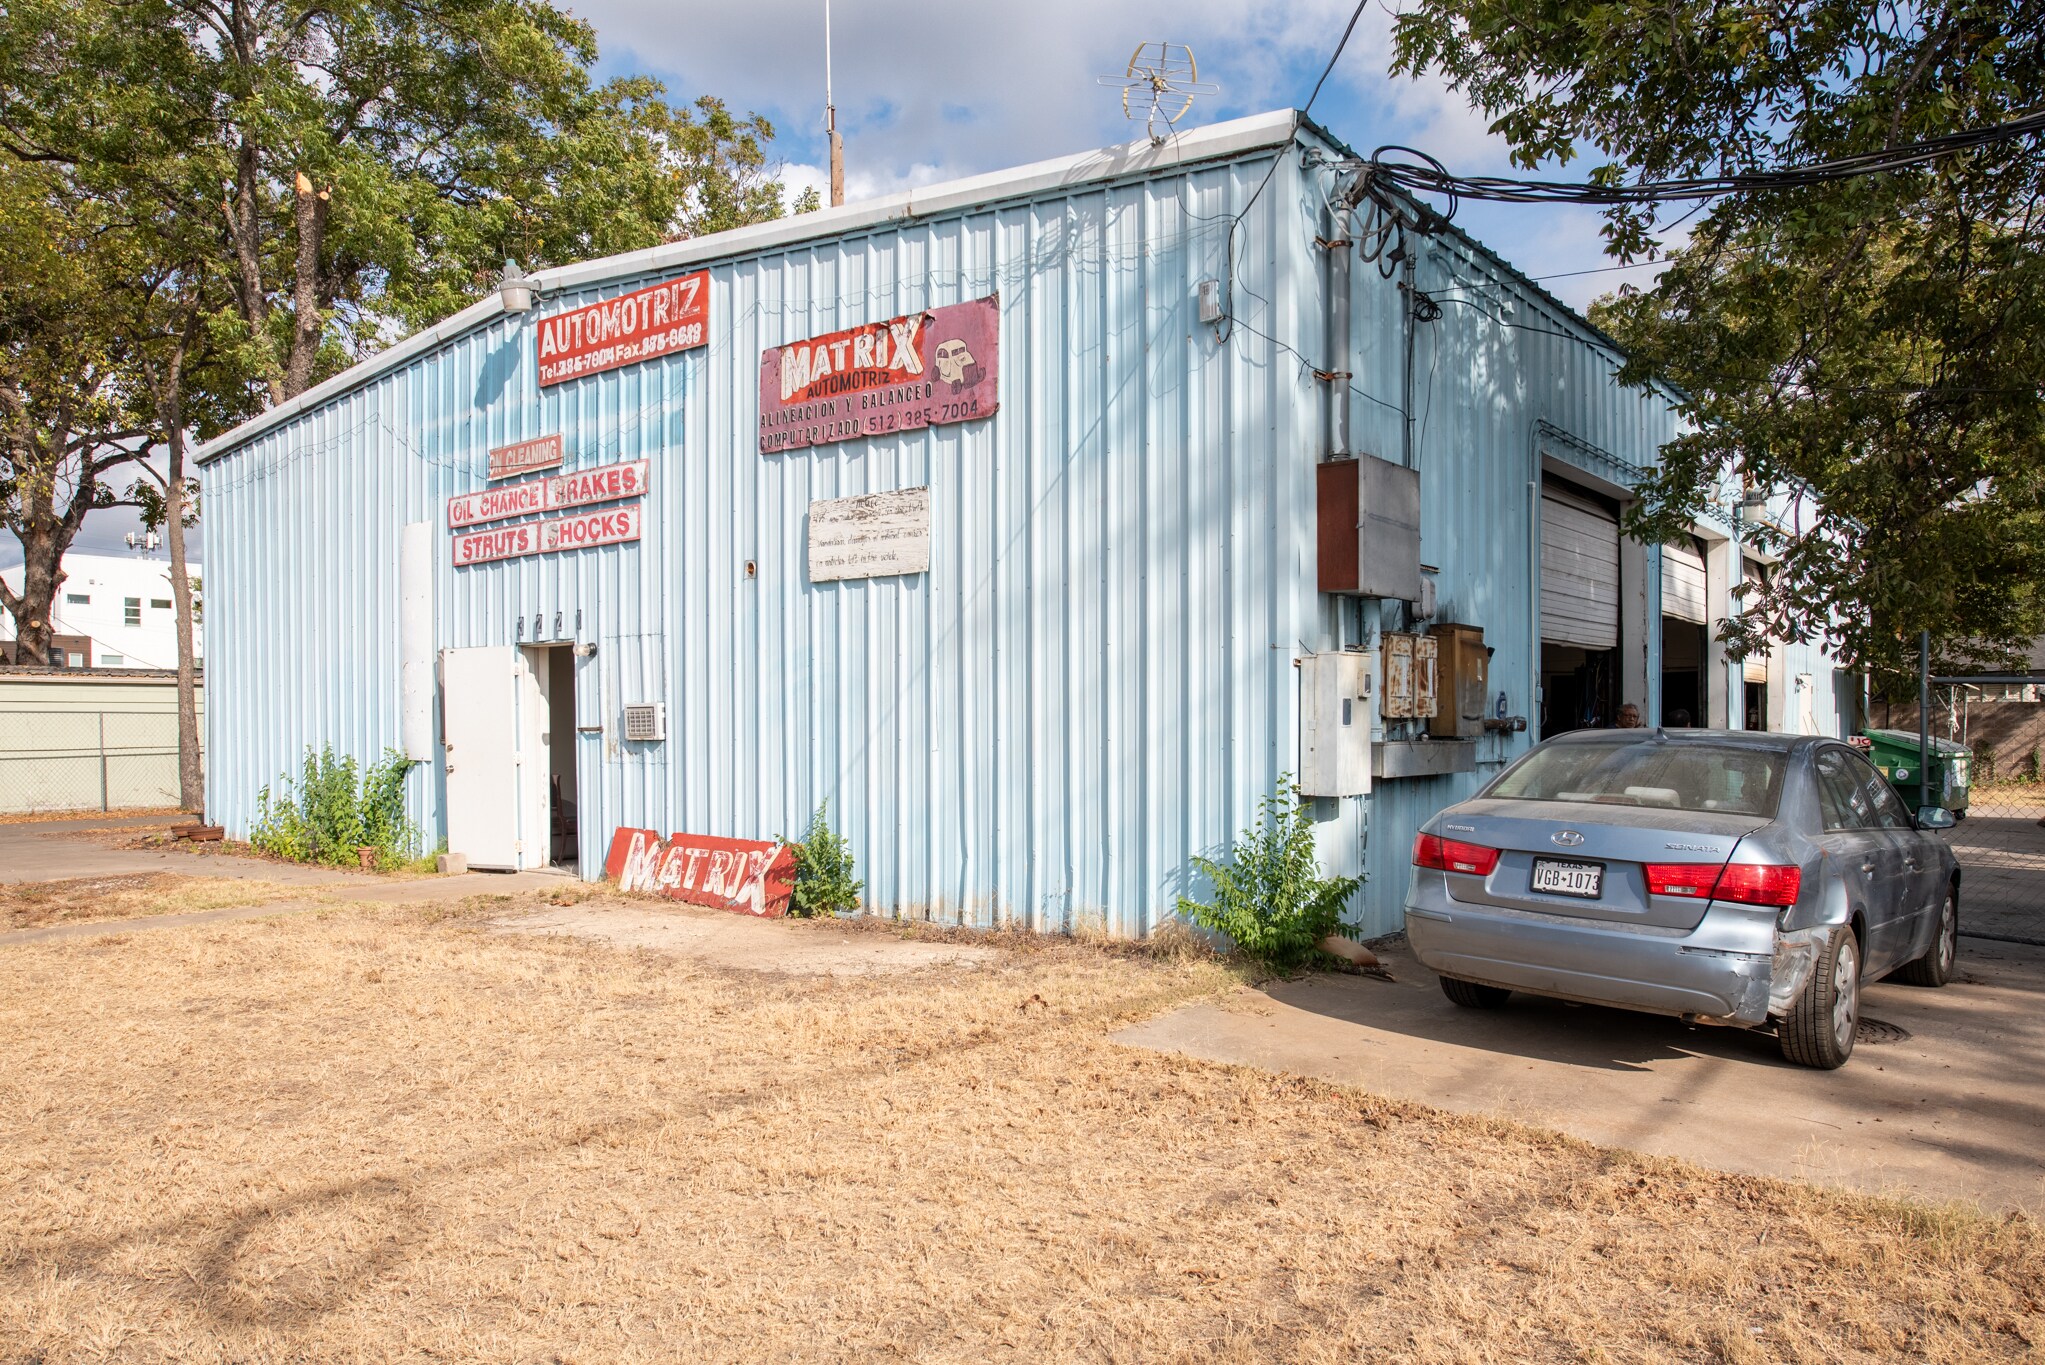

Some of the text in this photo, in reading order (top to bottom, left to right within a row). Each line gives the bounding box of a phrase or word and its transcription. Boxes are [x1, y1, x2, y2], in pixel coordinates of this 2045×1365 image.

[541, 277, 701, 358] AUTOMOTRIZ
[780, 313, 924, 401] MATRIX
[806, 371, 891, 399] AUTOMOTRIZ
[760, 400, 837, 429] ALINEACION
[845, 396, 854, 413] Y
[760, 417, 860, 449] COMPUTARIZADO
[506, 440, 557, 471] CLEANING
[453, 500, 474, 521] OIL
[462, 528, 529, 560] STRUTS
[547, 512, 631, 546] SHOCKS
[1664, 842, 1721, 854] SONATA
[619, 832, 783, 915] MATRIX
[1556, 862, 1584, 870] TEXAS
